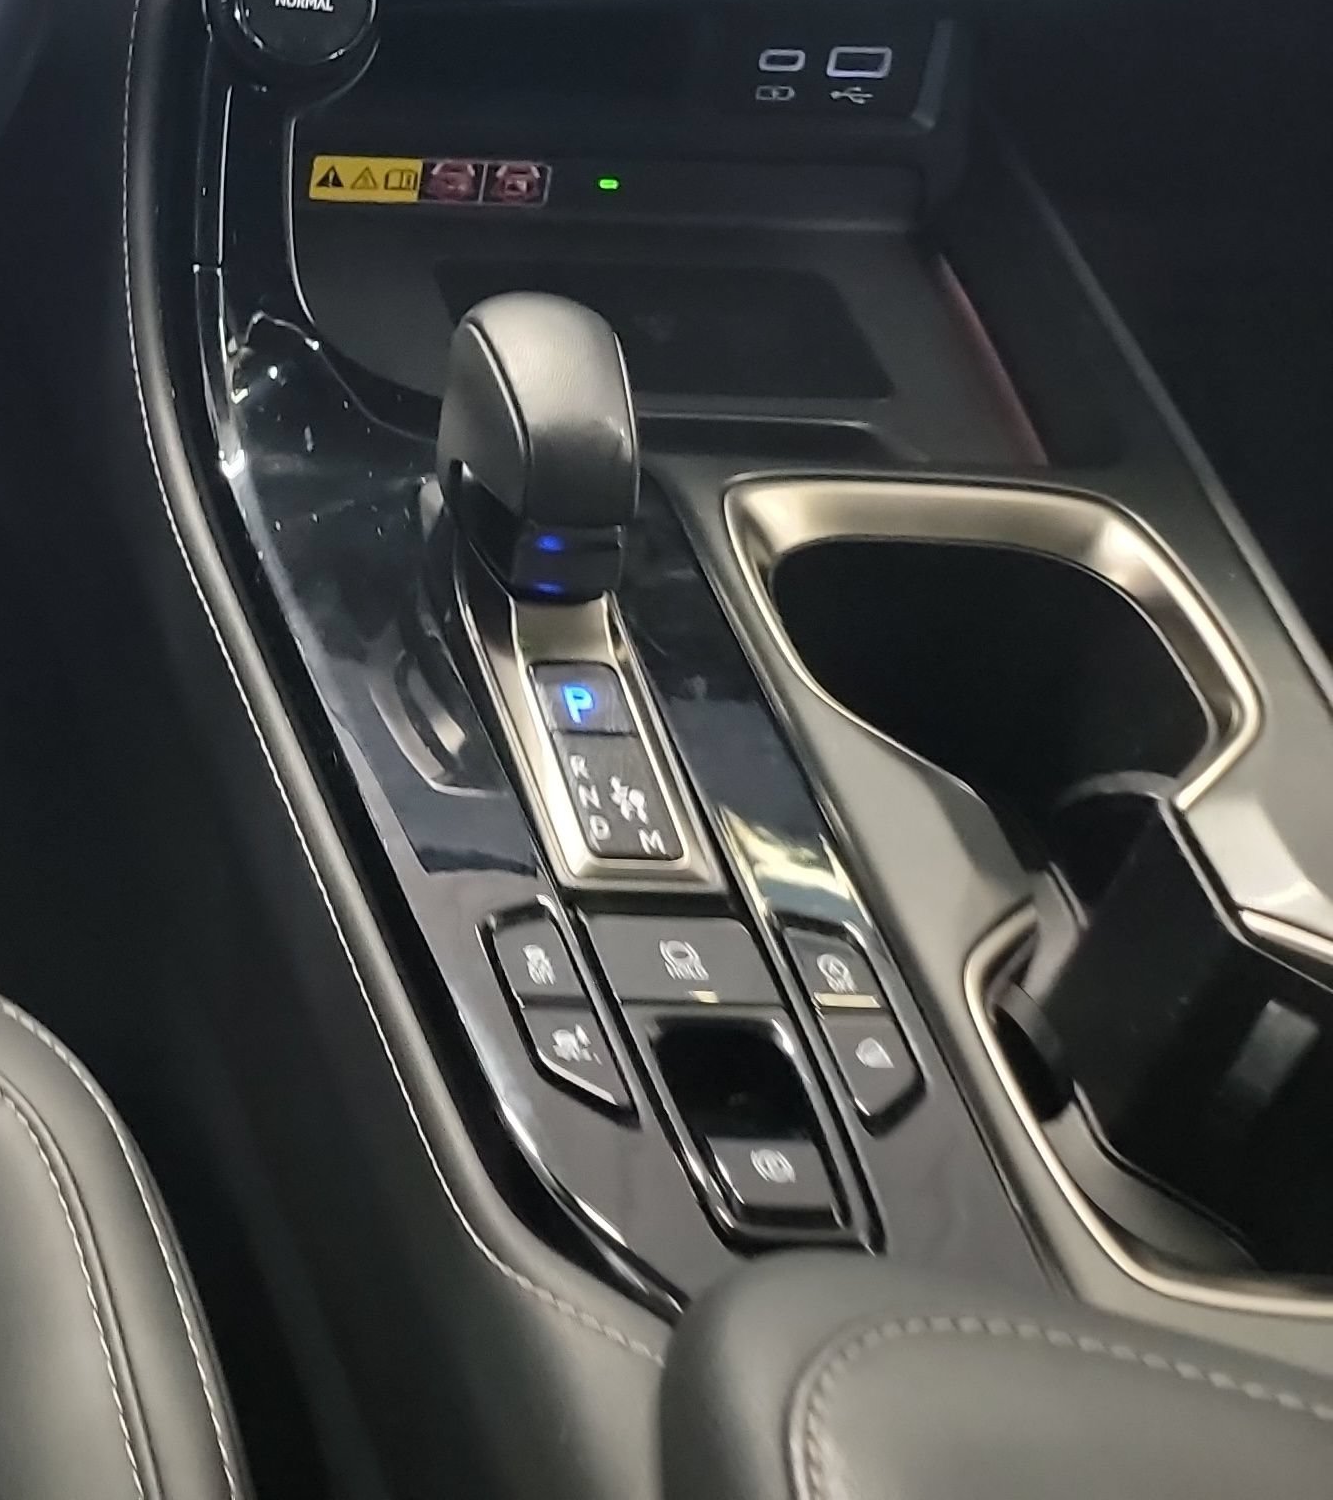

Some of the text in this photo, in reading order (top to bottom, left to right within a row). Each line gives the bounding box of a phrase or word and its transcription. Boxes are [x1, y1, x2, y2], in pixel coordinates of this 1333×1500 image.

[562, 684, 596, 723] P
[569, 754, 590, 780] R
[577, 784, 601, 809] N
[638, 828, 667, 855] M
